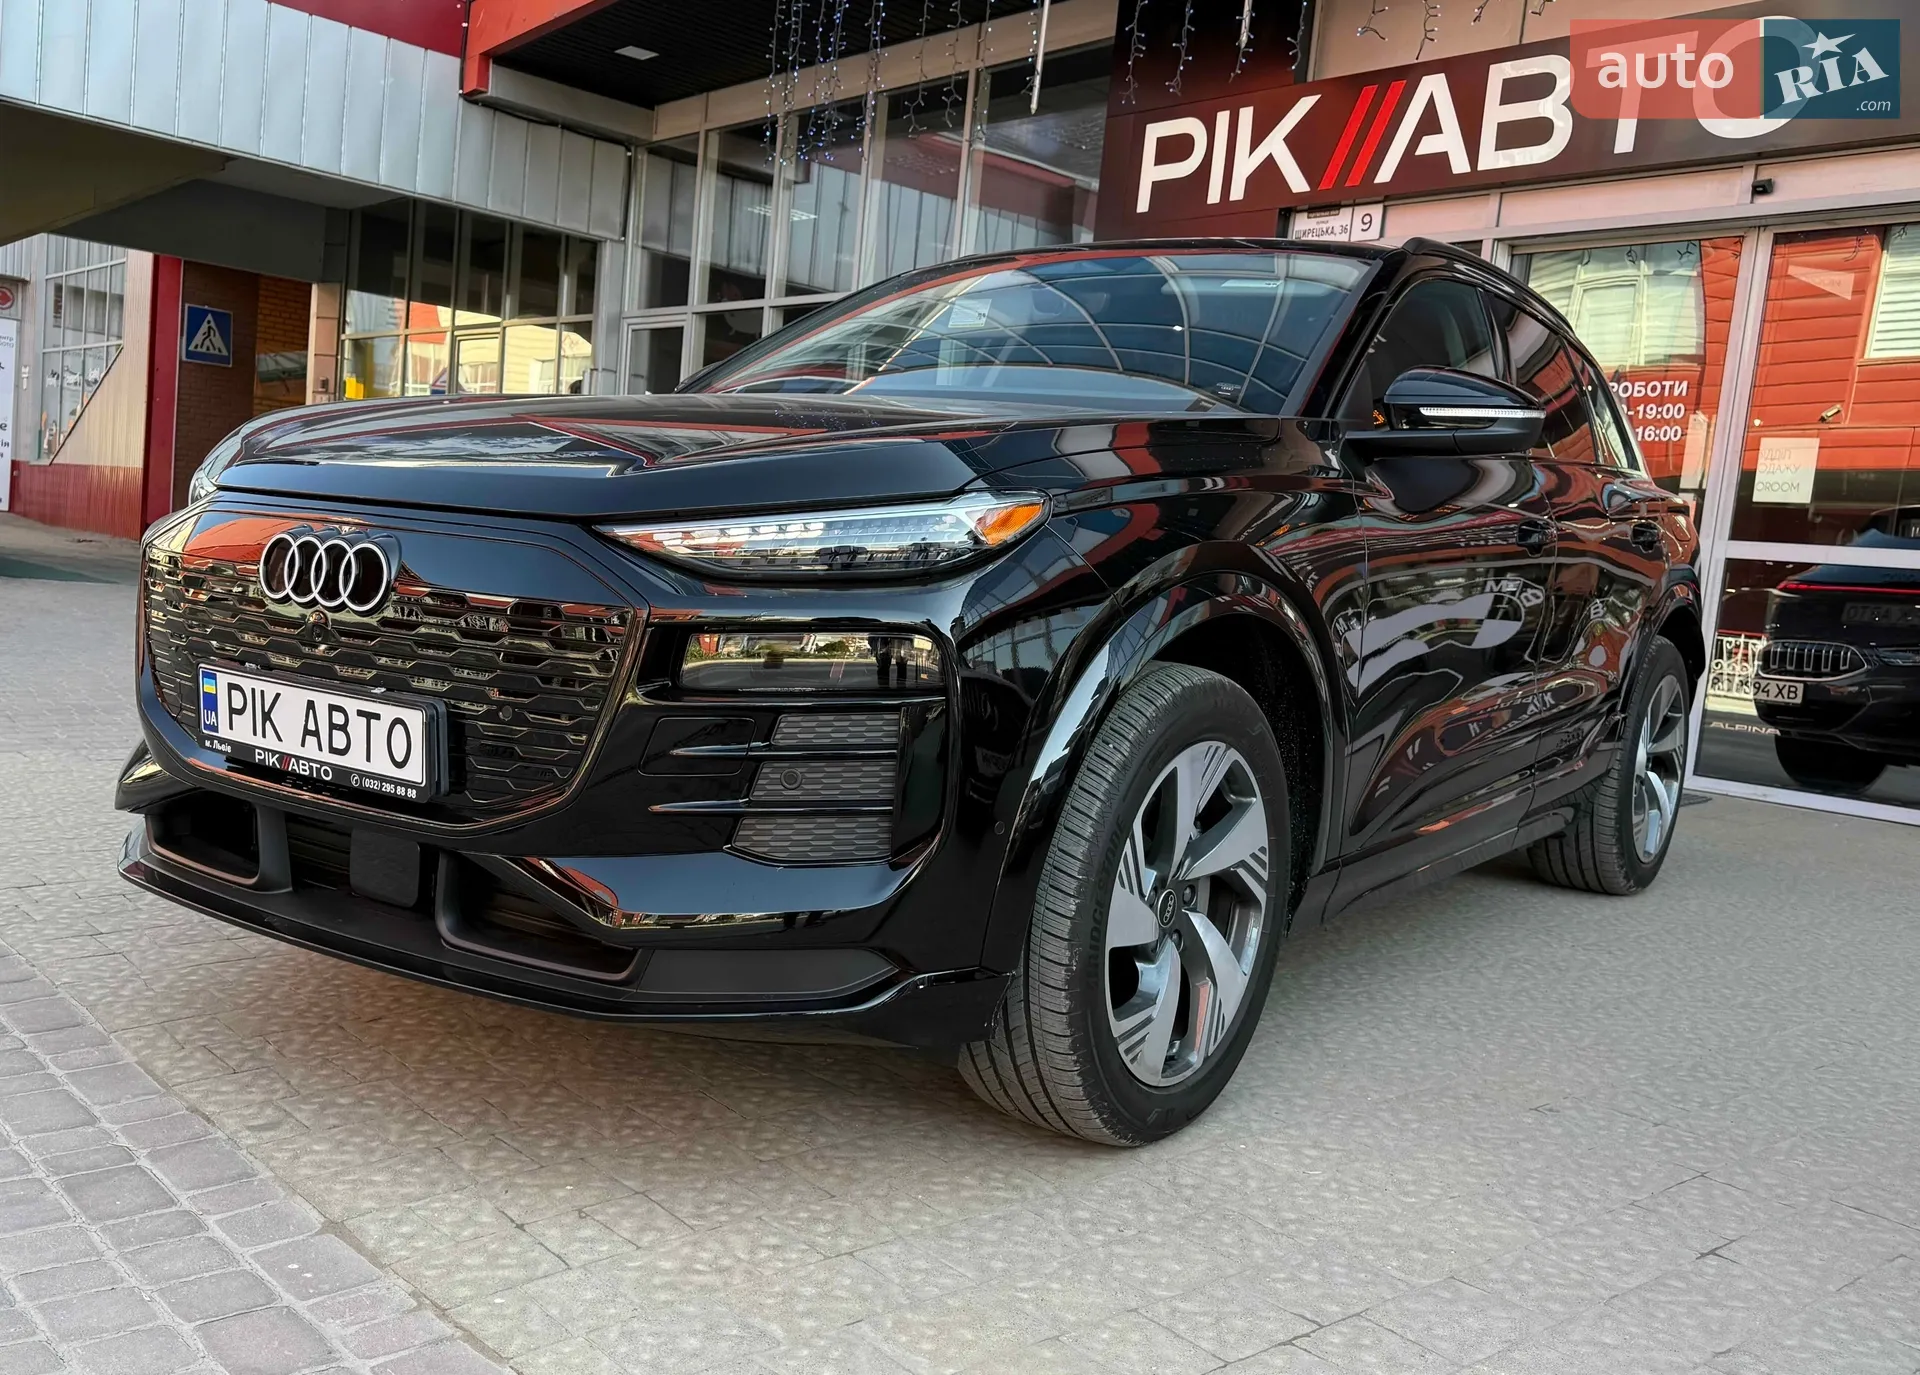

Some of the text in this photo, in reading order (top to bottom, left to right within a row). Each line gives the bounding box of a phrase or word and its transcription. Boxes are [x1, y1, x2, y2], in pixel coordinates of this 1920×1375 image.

[1339, 224, 1349, 235] 36
[1361, 213, 1373, 232] 9
[204, 709, 217, 727] UA
[1710, 721, 1781, 736] ALPINA
[362, 778, 417, 799] (032) 295 88 88
